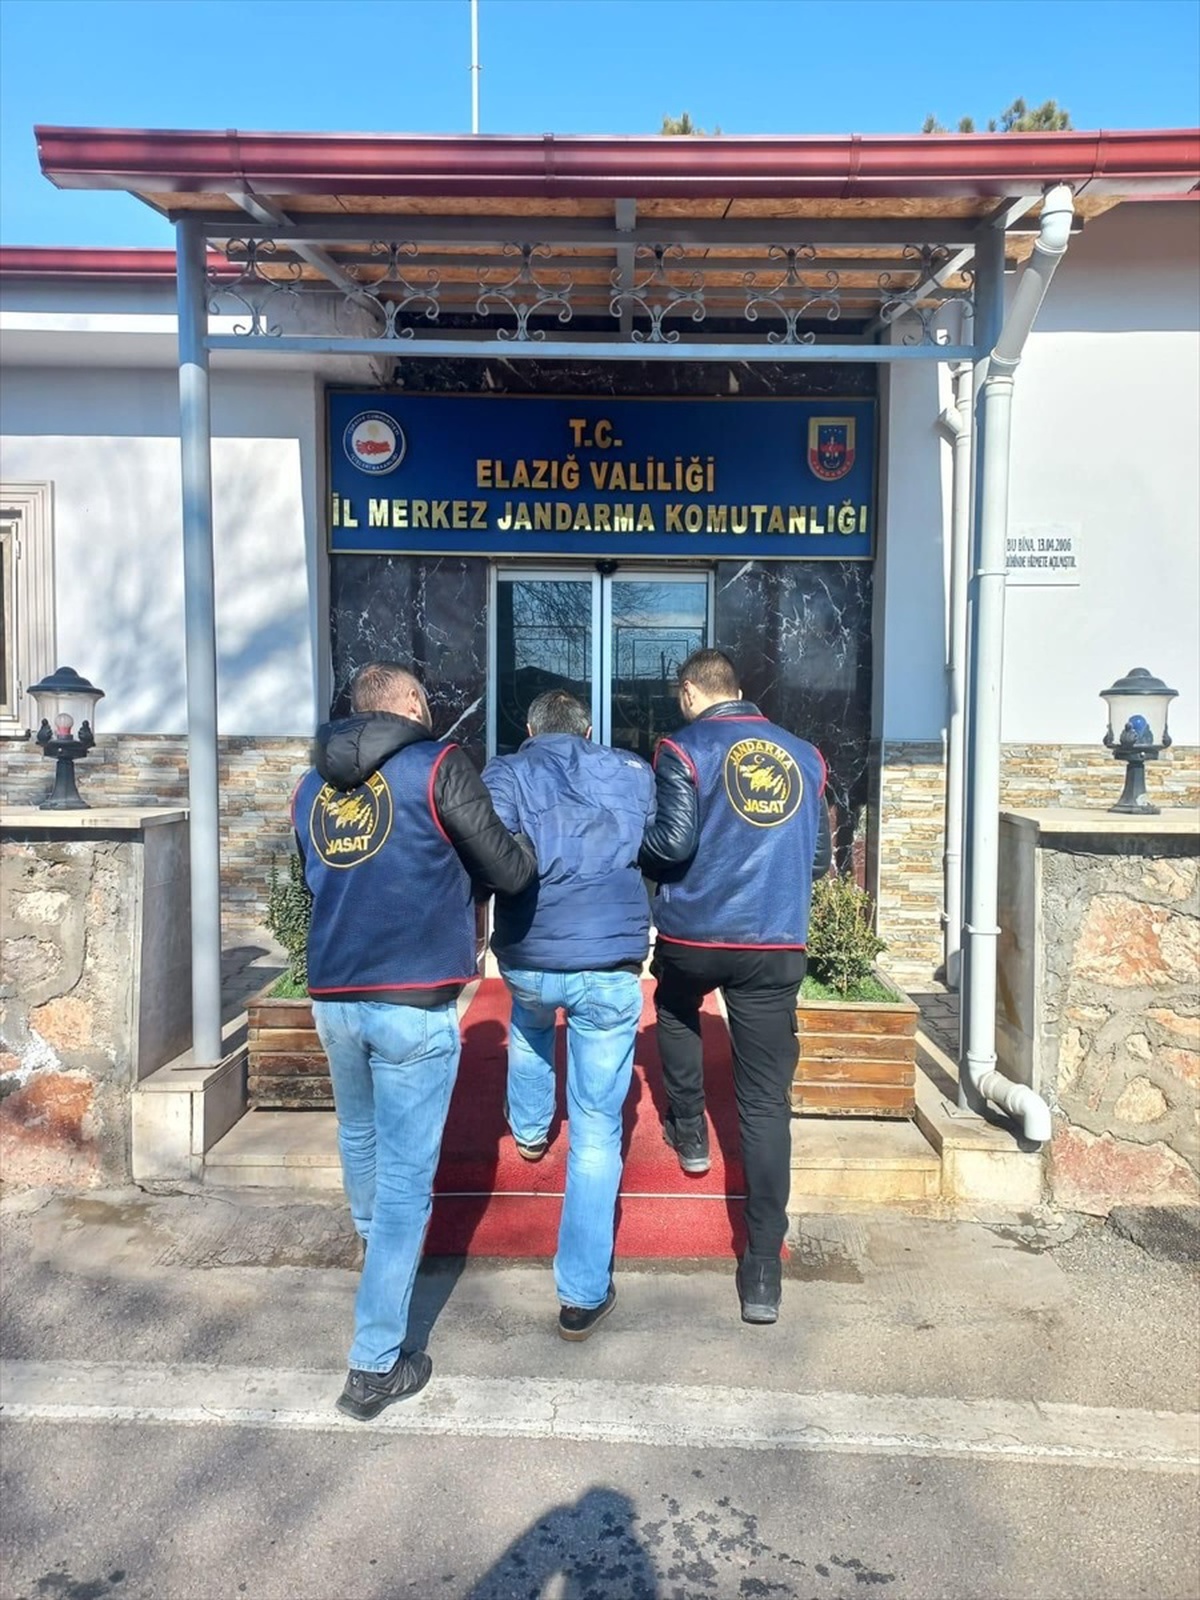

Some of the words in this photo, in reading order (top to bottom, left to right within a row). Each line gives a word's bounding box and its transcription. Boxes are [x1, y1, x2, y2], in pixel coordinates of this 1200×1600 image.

[569, 418, 623, 449] T.C.
[476, 453, 580, 490] ELAZIĞ
[590, 456, 714, 492] VALİLİĞİ
[332, 493, 358, 528] İL
[368, 498, 488, 529] MERKEZ
[497, 501, 655, 533] JANDARMA
[665, 499, 867, 535] KOMUTANLIĞI
[1006, 538, 1017, 552] BU
[730, 741, 793, 770] JANDARMA
[743, 798, 786, 814] JASAT
[325, 835, 372, 856] JASAT
